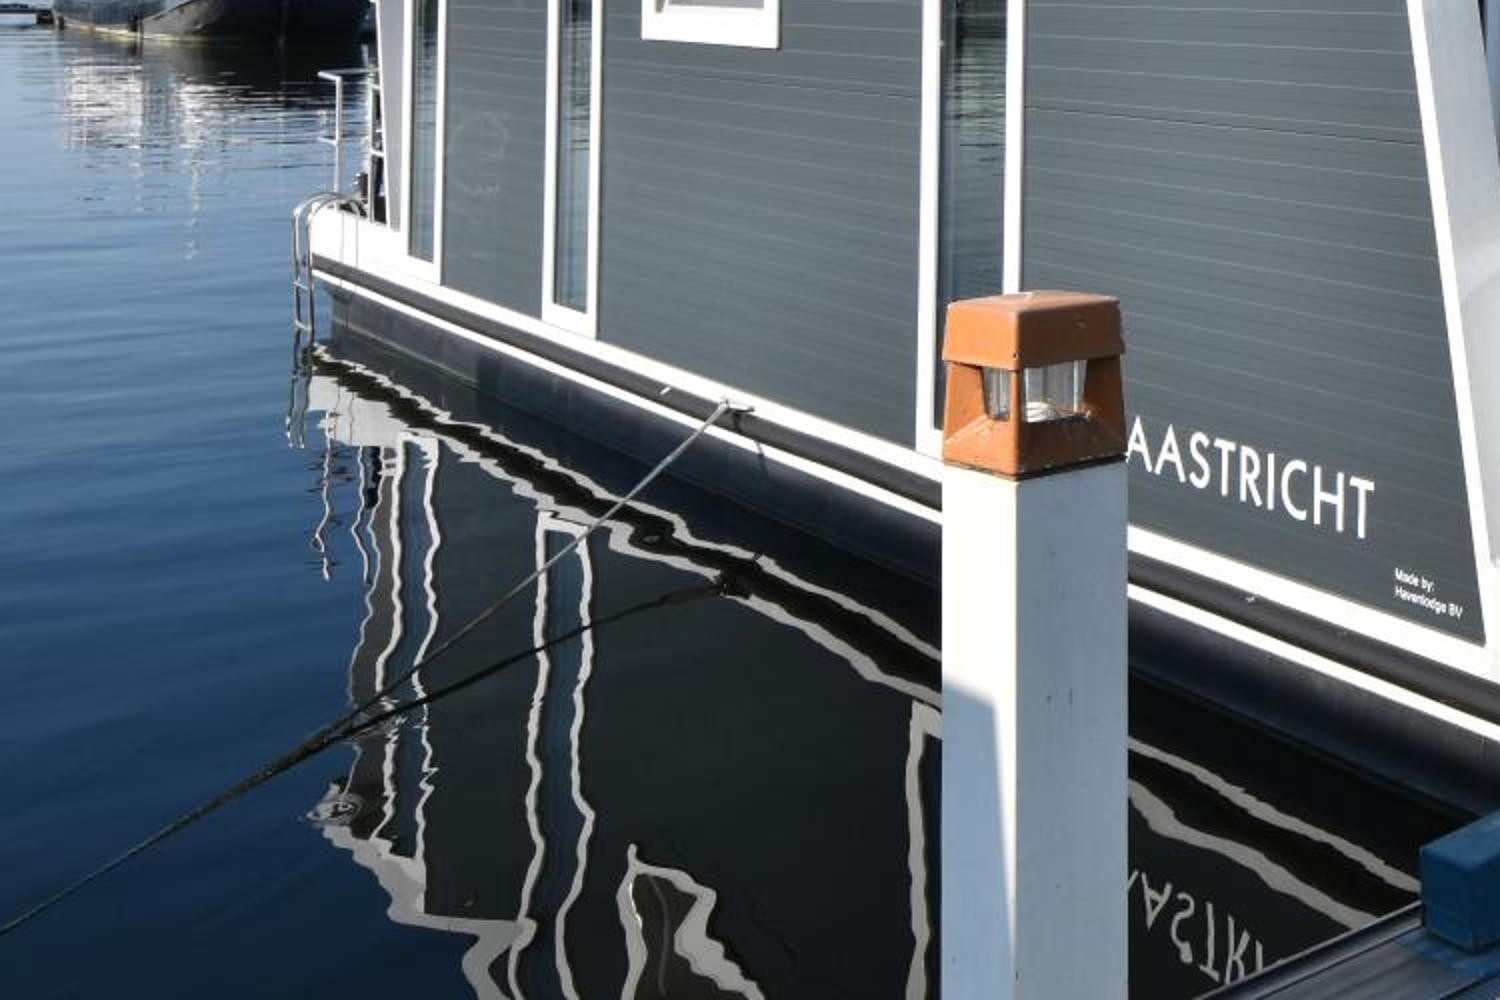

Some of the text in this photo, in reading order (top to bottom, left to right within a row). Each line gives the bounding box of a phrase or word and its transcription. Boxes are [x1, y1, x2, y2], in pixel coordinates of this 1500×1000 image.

[1126, 414, 1375, 539] AASTRICHT
[1395, 567, 1419, 587] Made
[1448, 602, 1463, 620] BV
